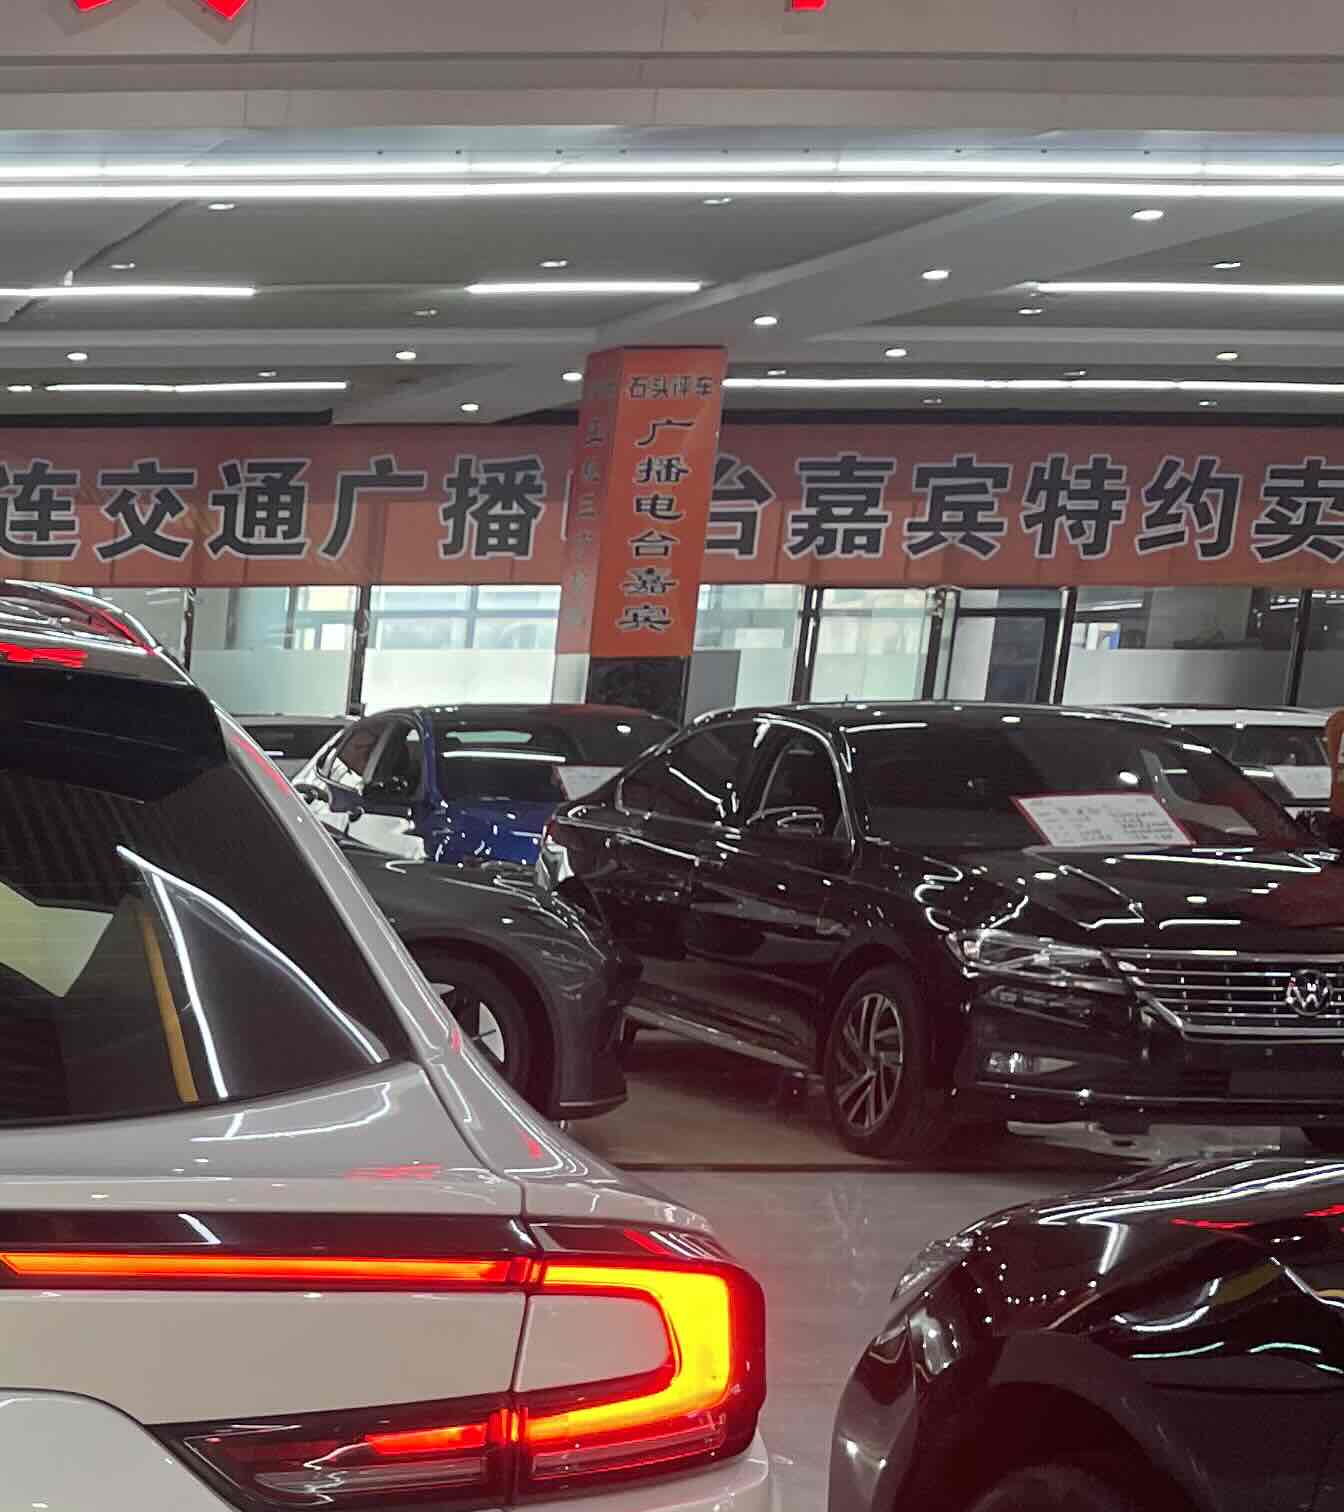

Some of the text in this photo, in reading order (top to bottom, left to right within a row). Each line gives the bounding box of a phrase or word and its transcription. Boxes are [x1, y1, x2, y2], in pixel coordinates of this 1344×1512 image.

[616, 417, 695, 632] 广播电台嘉宾
